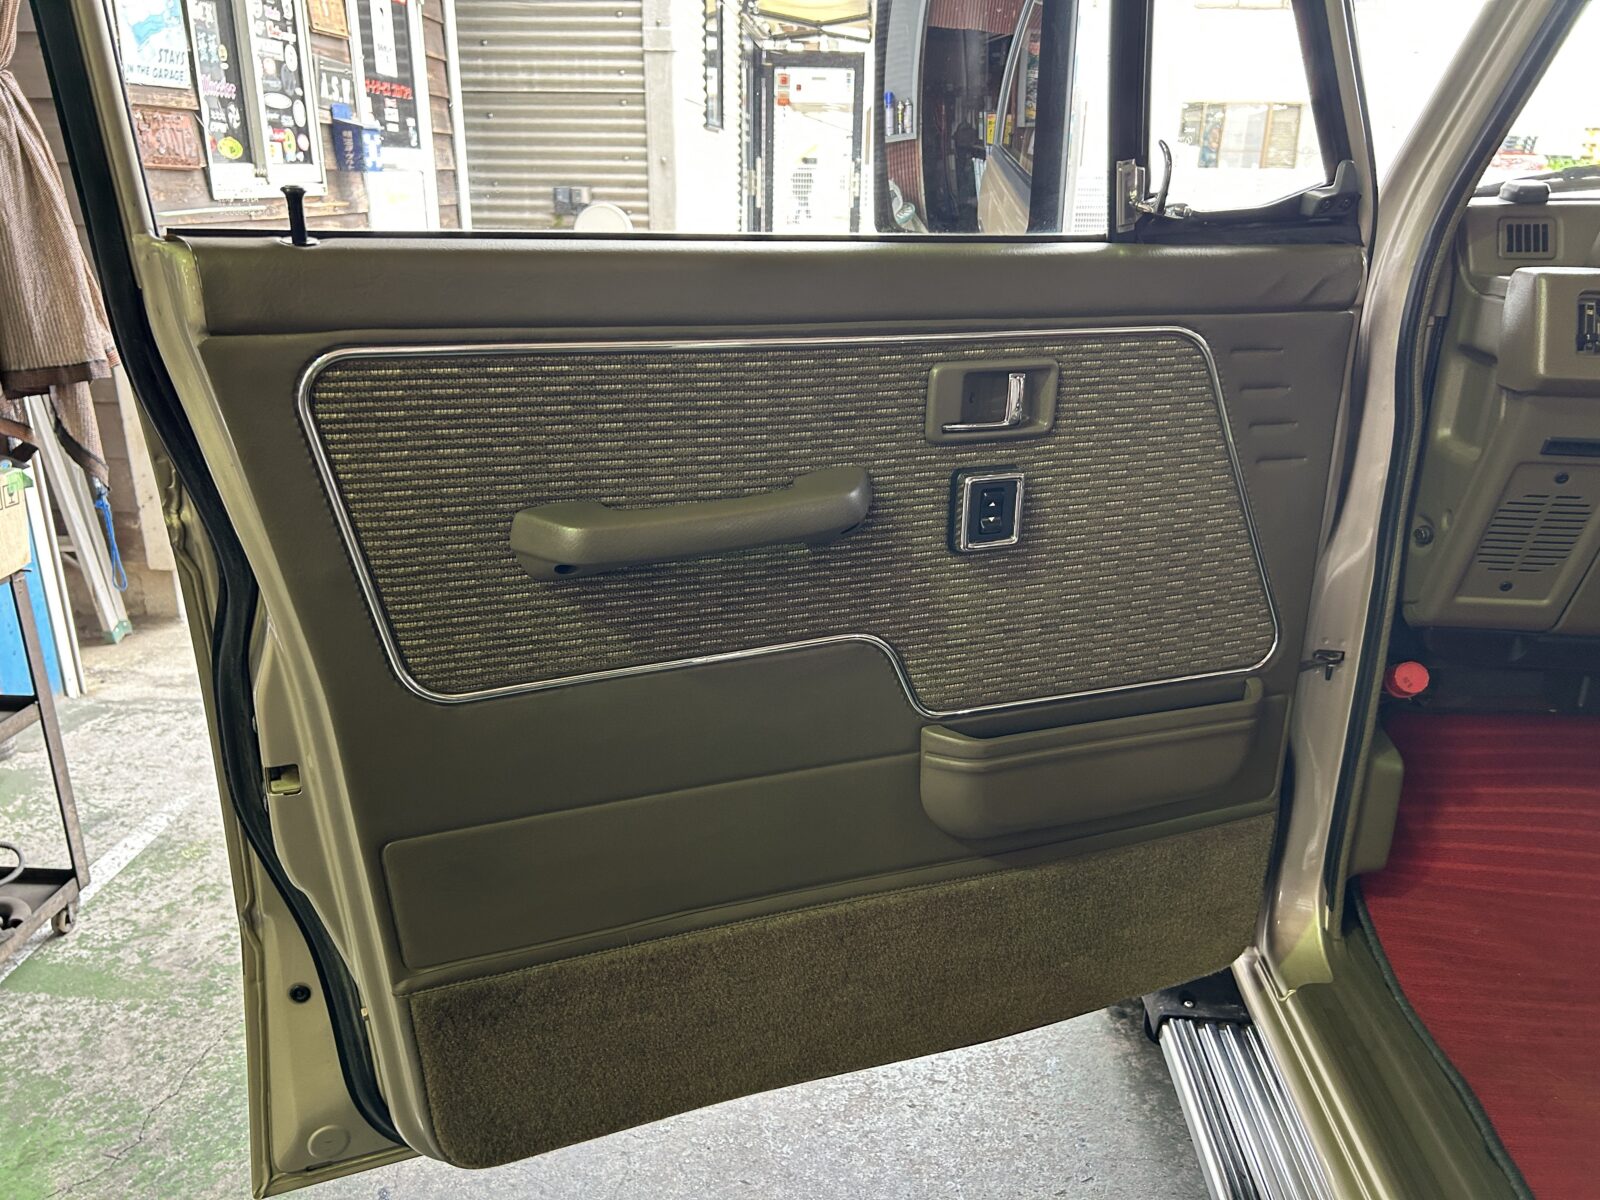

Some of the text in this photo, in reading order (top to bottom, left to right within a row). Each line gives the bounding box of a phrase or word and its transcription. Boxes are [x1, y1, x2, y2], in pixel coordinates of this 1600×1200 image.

[158, 48, 185, 65] STAYS
[137, 65, 150, 76] THE
[153, 67, 184, 81] GARAGE
